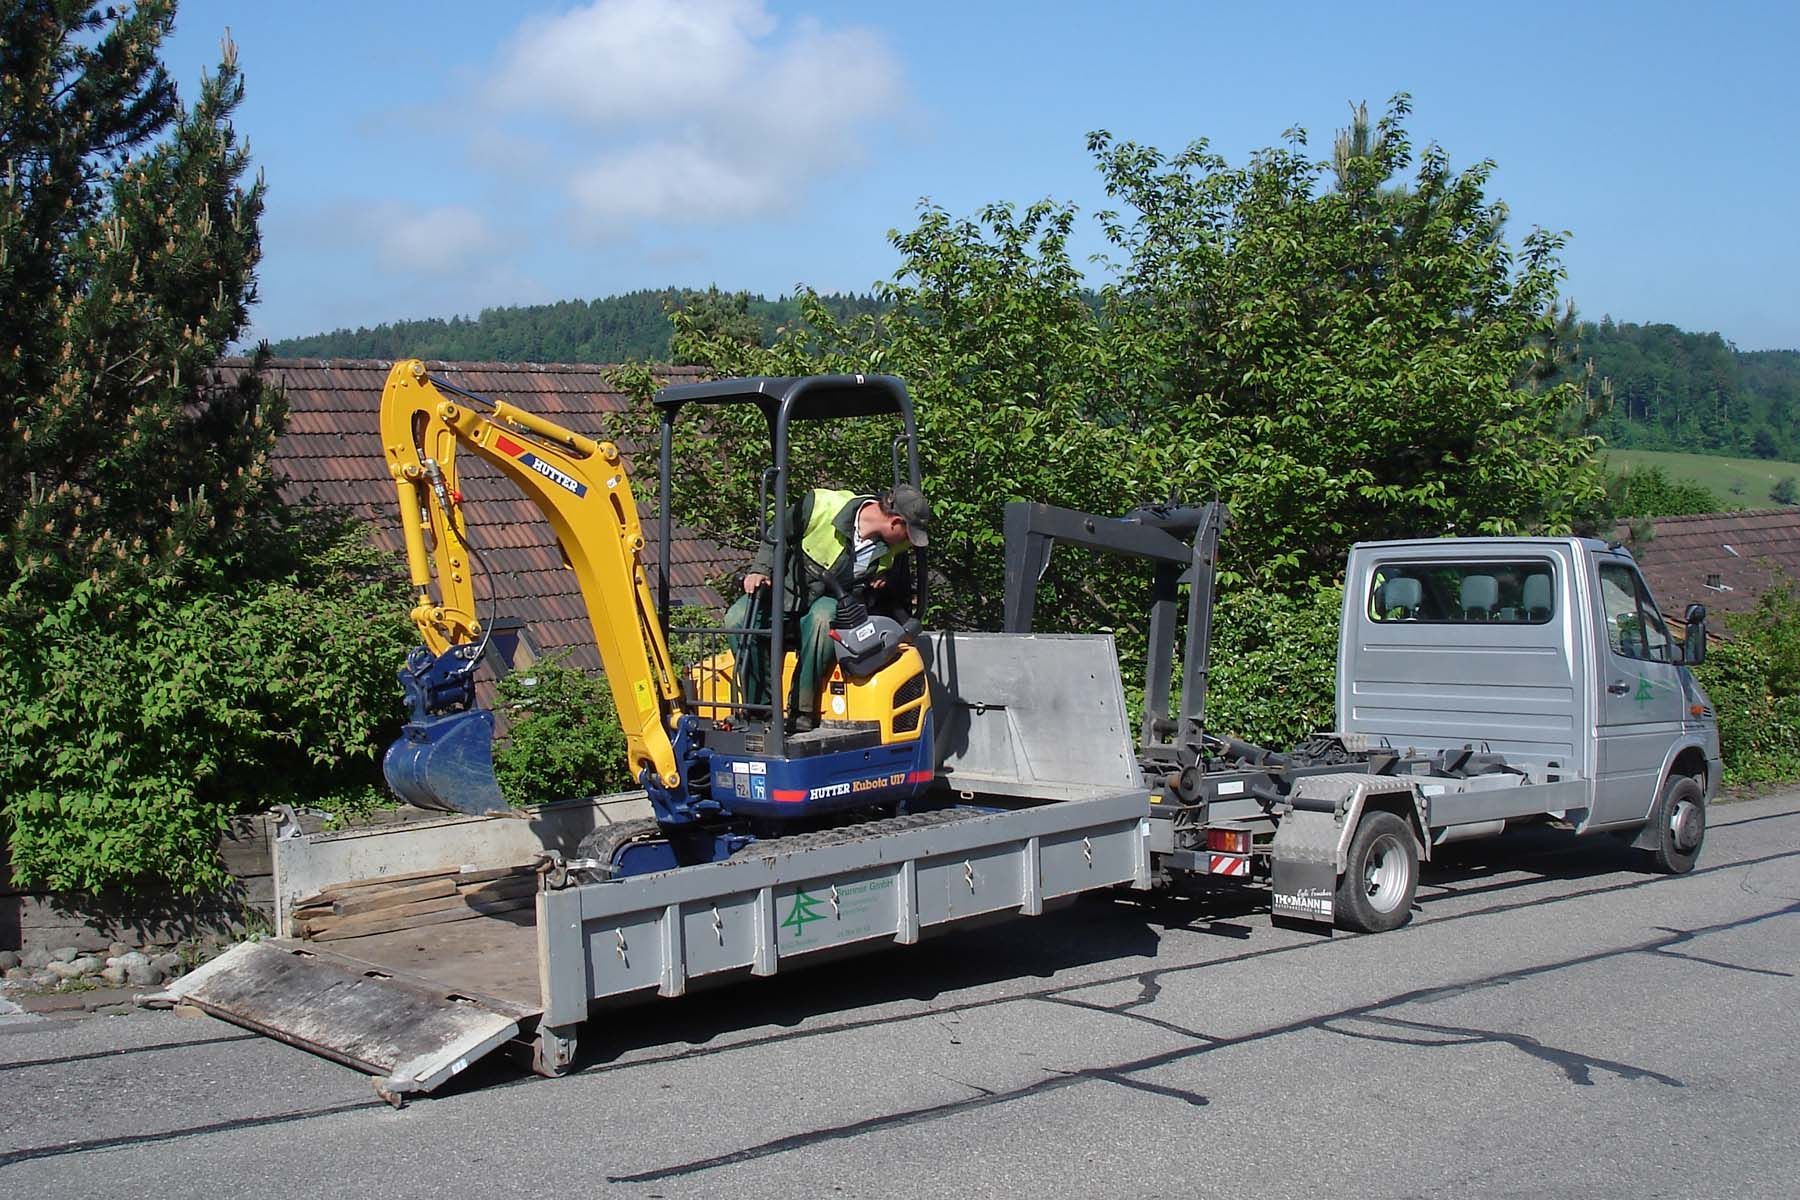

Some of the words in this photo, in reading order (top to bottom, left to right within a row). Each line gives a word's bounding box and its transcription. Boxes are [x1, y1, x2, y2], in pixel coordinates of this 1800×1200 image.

[532, 457, 578, 493] HUTTER
[809, 783, 850, 800] HUTTER
[852, 778, 888, 792] Kubota
[869, 879, 894, 890] GmbH
[1274, 894, 1321, 910] THOMANN
